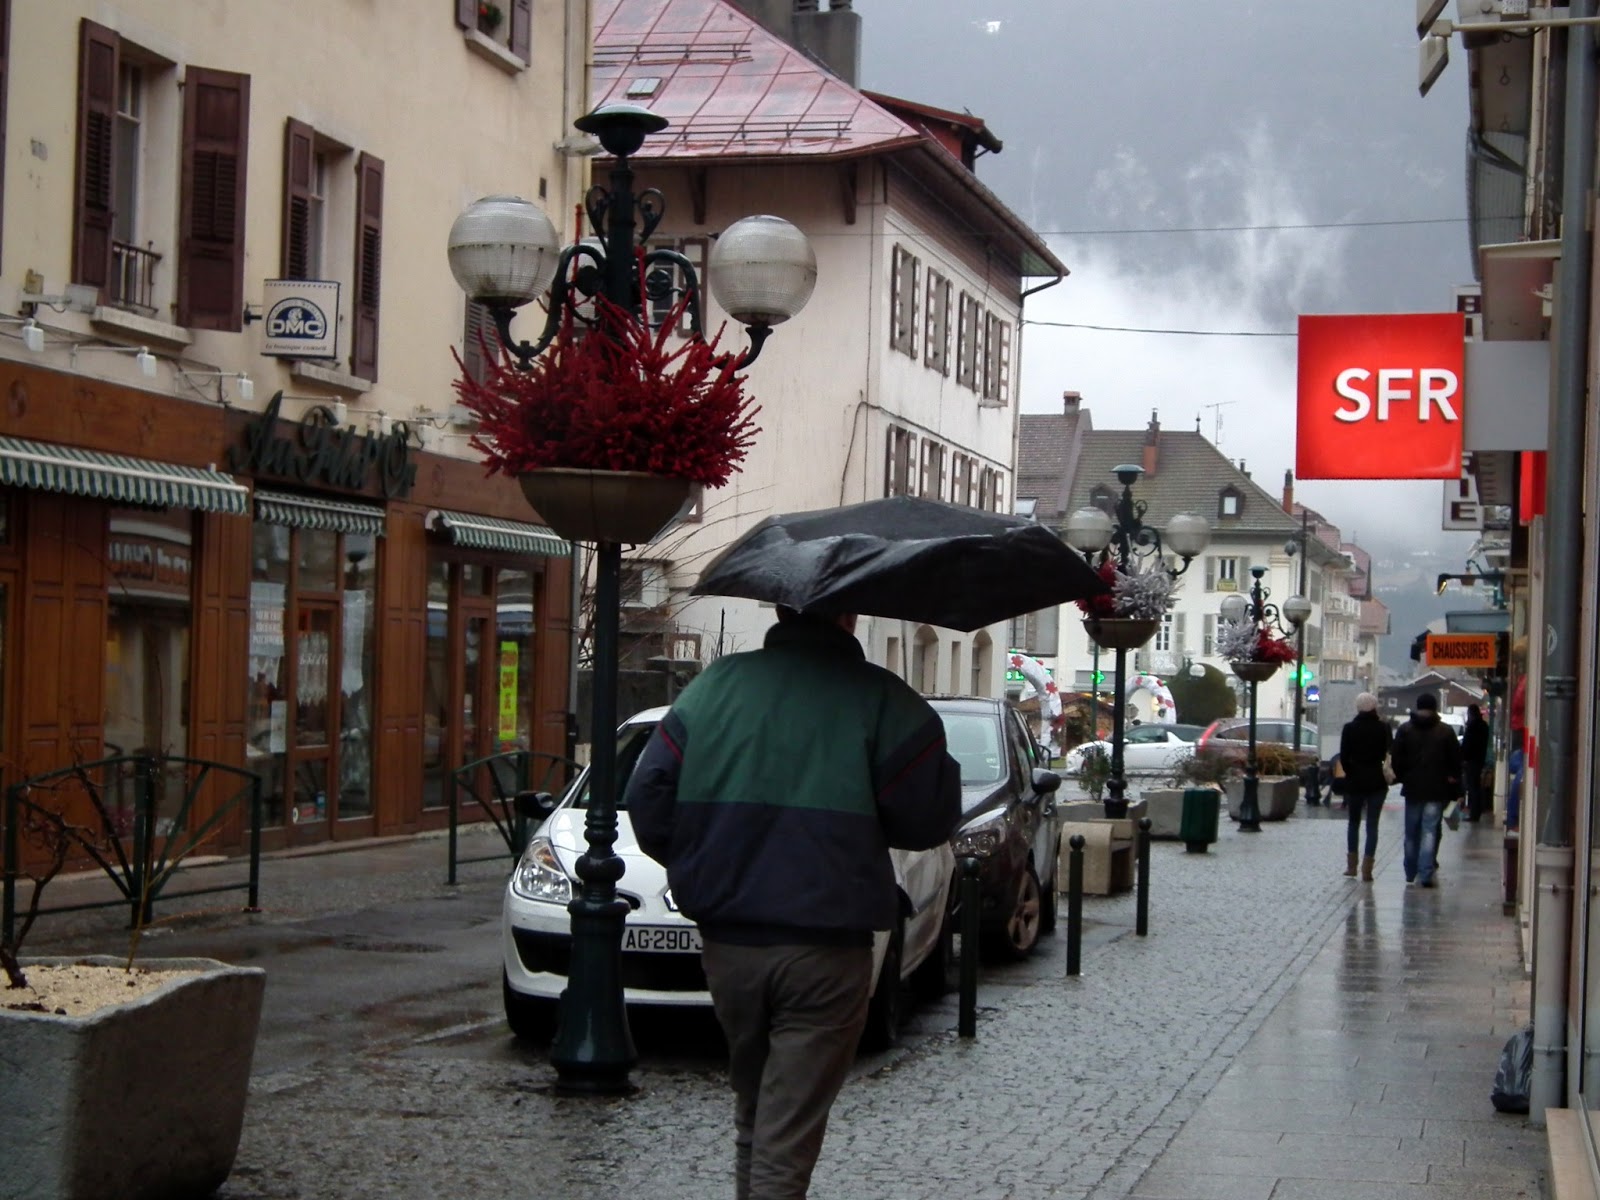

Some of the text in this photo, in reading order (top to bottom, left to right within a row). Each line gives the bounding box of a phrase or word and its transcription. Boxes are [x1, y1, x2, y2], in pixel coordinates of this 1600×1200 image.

[269, 319, 322, 336] DMC
[1334, 367, 1459, 422] SFR
[1432, 641, 1489, 660] CHAUSSURES
